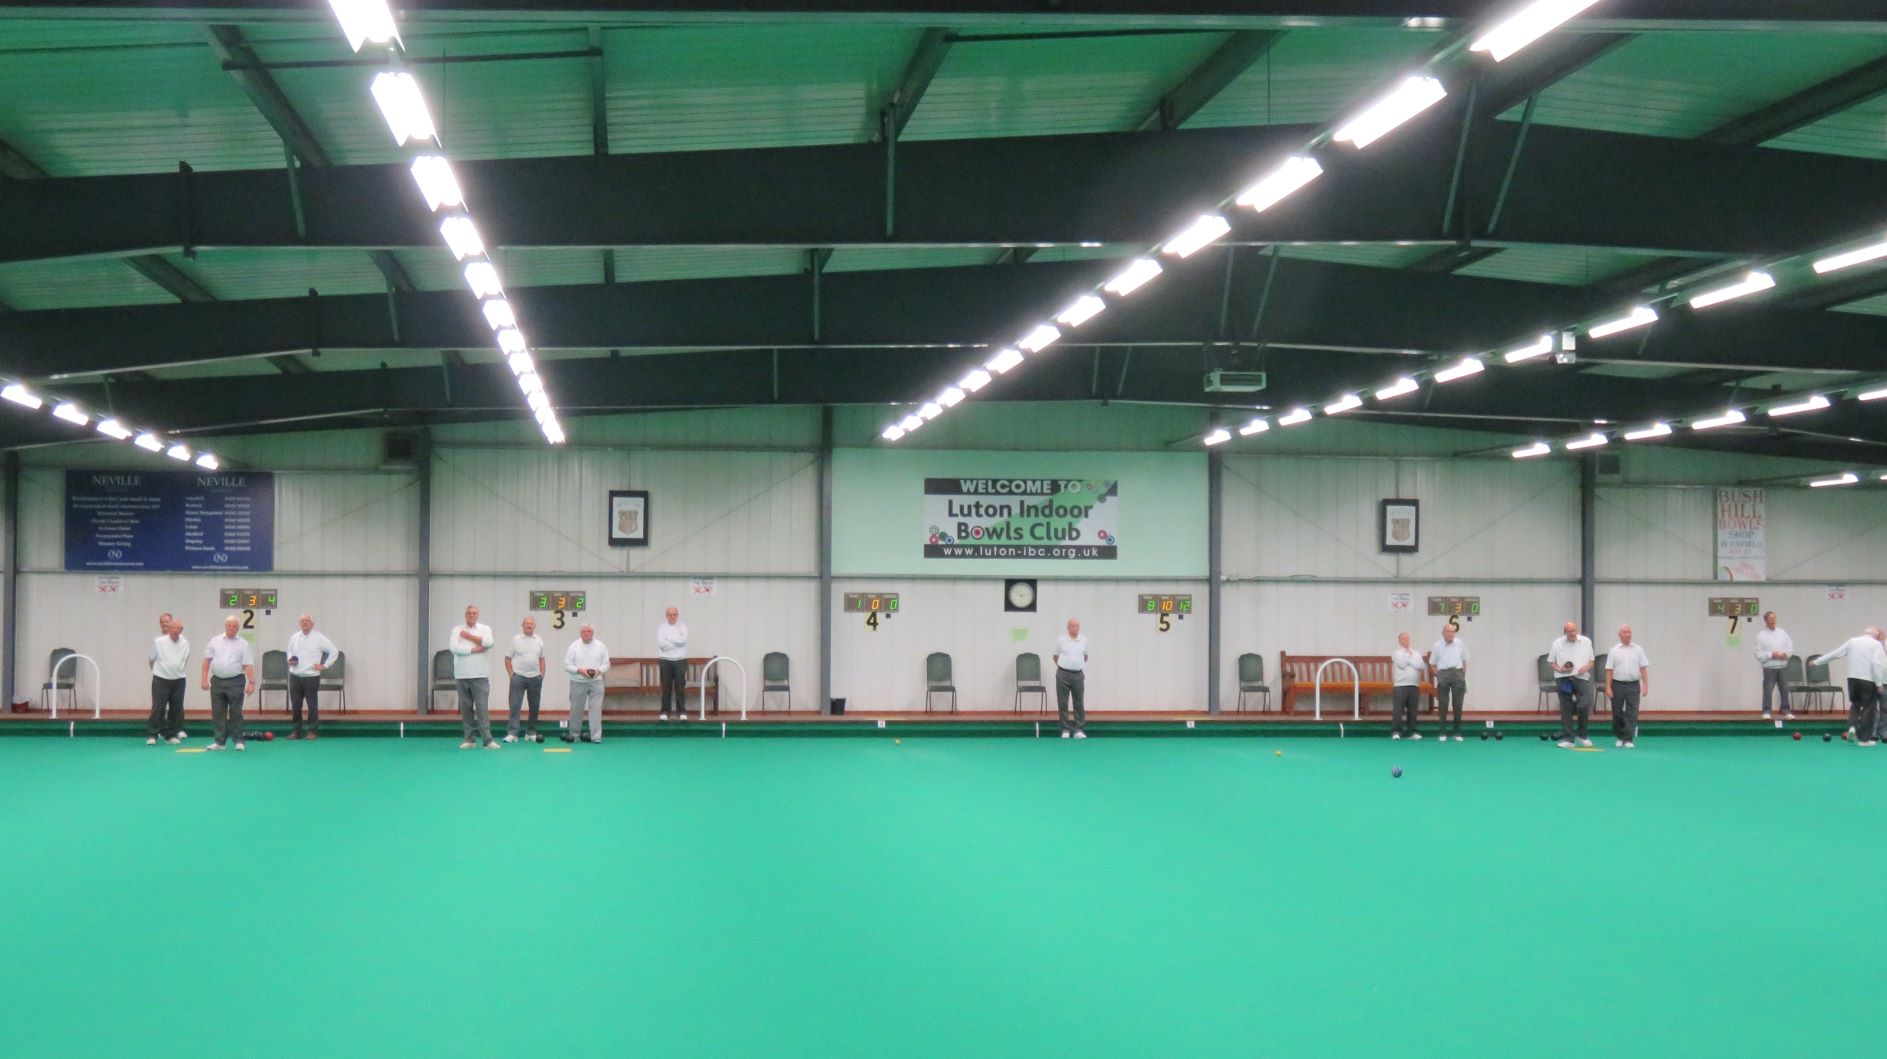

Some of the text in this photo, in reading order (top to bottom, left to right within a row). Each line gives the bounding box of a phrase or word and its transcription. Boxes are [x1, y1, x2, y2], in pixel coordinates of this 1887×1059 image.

[93, 476, 142, 486] NEVILLE
[197, 477, 246, 487] NEVILLE
[960, 479, 1081, 494] WELCOME TO
[1719, 489, 1763, 504] BUSH
[948, 499, 1093, 518] Luton Indoor
[1720, 503, 1762, 519] HILL
[957, 521, 1081, 541] Bowls Club
[1718, 518, 1764, 530] BOWLS
[943, 546, 1099, 559] www.luton-ibc.org.uk
[229, 595, 276, 606] 2 3 4
[539, 597, 584, 608] 3 3 2
[871, 599, 880, 610] 0
[890, 599, 898, 610] 0
[1162, 600, 1173, 611] 10
[1179, 600, 1190, 611] 12
[1455, 602, 1462, 613] 3
[1471, 602, 1479, 613] 0
[1750, 603, 1758, 614] 0
[243, 609, 254, 629] 2
[553, 610, 565, 630] 3
[866, 611, 879, 631] 4
[1159, 612, 1170, 632] 5
[1728, 615, 1738, 634] 7
